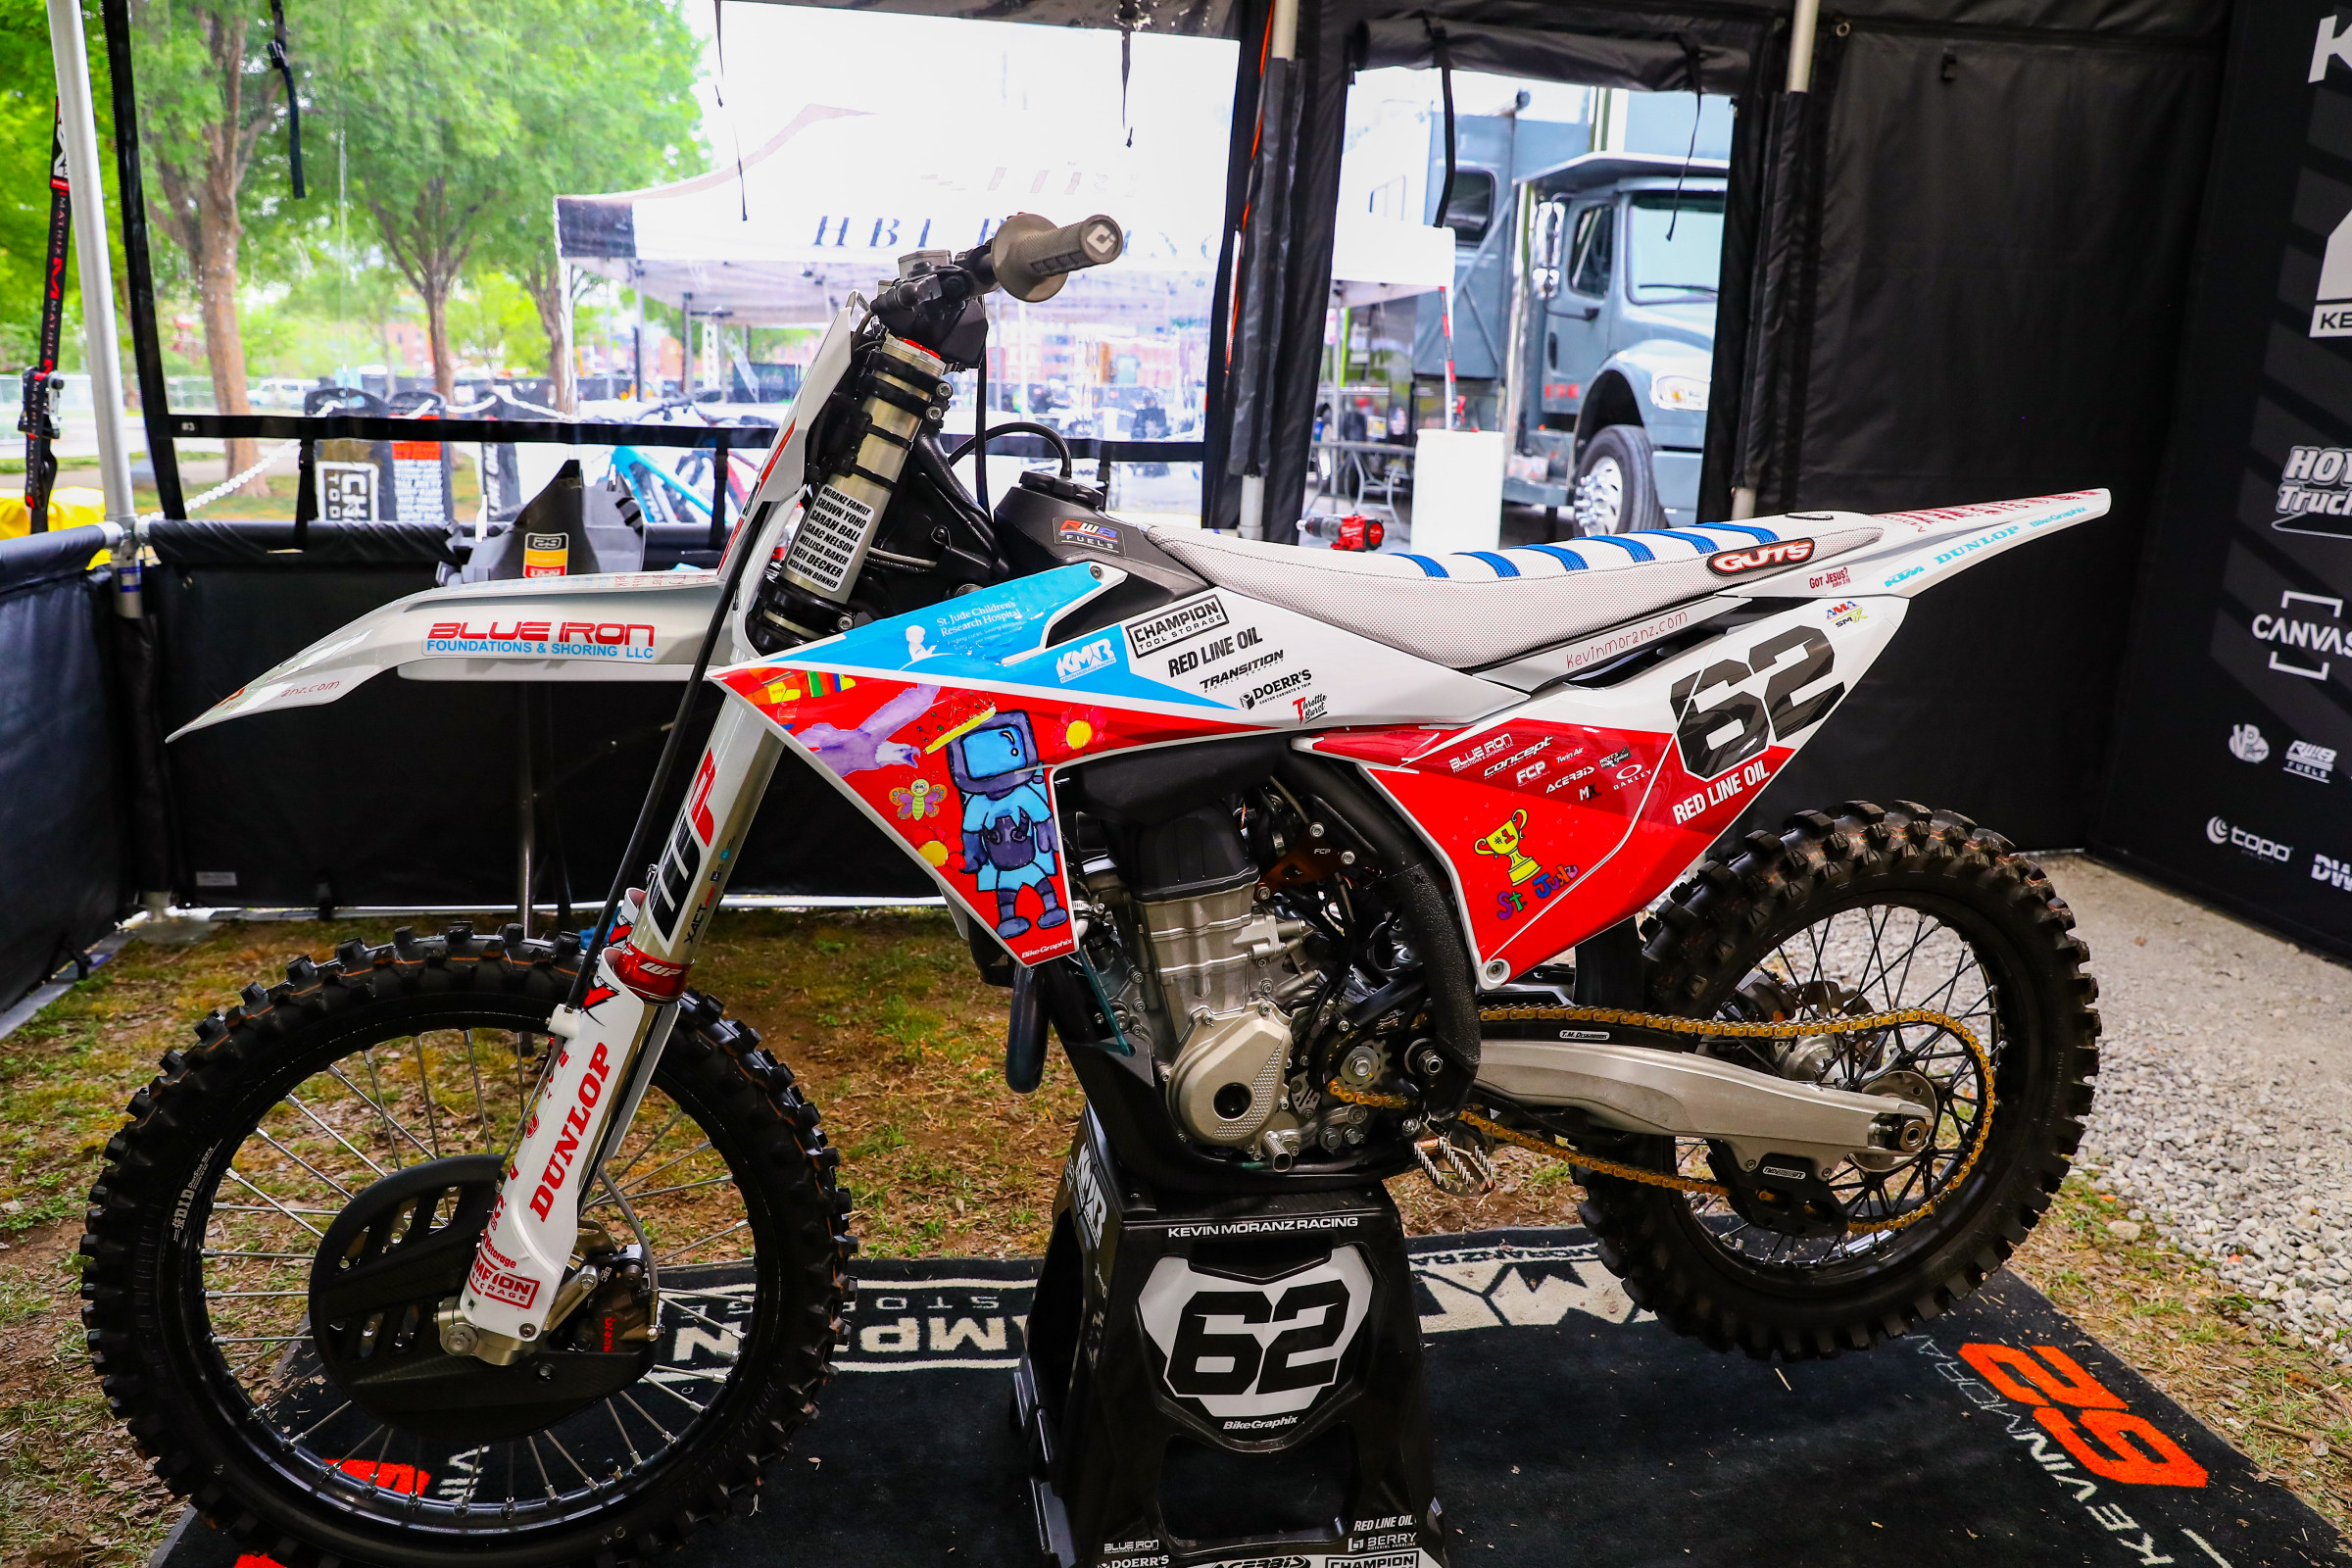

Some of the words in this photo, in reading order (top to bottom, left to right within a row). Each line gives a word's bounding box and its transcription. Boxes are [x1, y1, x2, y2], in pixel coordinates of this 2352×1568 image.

[815, 498, 845, 517] SHAWN
[843, 511, 866, 528] YOHO
[847, 499, 871, 515] FAMILY
[805, 522, 824, 539] ISAAC
[824, 534, 855, 554] NELSON
[809, 510, 838, 530] SARAH
[838, 525, 861, 542] BALL
[824, 547, 849, 565] BAKER
[1066, 535, 1113, 549] FUELS
[1712, 541, 1813, 572] GUTS
[1935, 525, 2020, 564] DUNLOP
[808, 553, 843, 577] DECKER
[812, 570, 838, 588] BONNER
[1885, 565, 1925, 588] KTM
[937, 616, 950, 627] St.
[950, 611, 971, 624] Jude
[971, 601, 1016, 617] Children's
[941, 619, 983, 636] Research
[983, 609, 1021, 626] Hospital
[1134, 601, 1219, 643] CHAMPION
[1826, 601, 1858, 619] AMA
[427, 621, 552, 641] BLUE
[559, 622, 656, 647] IRON
[1139, 635, 1167, 651] TOOL
[1172, 614, 1222, 637] STORAGE
[1566, 612, 1688, 669] kevinmoranz.com
[427, 640, 531, 654] FOUNDATIONS
[536, 643, 546, 654] &
[552, 643, 617, 657] SHORING
[626, 647, 654, 659] LLC
[1168, 651, 1199, 678] RED
[1200, 636, 1235, 663] LINE
[1236, 626, 1263, 651] OIL
[1200, 649, 1284, 690] TRANSITION
[1252, 668, 1312, 701] DOERR'S
[1670, 624, 1845, 779] 62
[1448, 746, 1485, 770] BLUE
[1484, 733, 1513, 754] IRON
[1484, 736, 1553, 777] concept
[1556, 752, 1573, 764] Twin
[1573, 746, 1584, 758] Air
[1516, 760, 1546, 784] FCP
[1545, 765, 1594, 794] ACERBIS
[1613, 768, 1651, 791] OAKLEY
[2287, 761, 2328, 779] FUELS
[1672, 792, 1707, 825] RED
[1706, 773, 1743, 807] LINE
[1743, 760, 1771, 787] OIL
[2231, 825, 2291, 862] topo
[1496, 890, 1528, 921] St.
[684, 904, 707, 945] XACT
[529, 1042, 610, 1223] DUNLOP
[1168, 1225, 1219, 1238] KEVIN
[1221, 1220, 1296, 1235] MORANZ
[1297, 1217, 1358, 1230] RACING
[1166, 1279, 1350, 1395] 62
[1223, 1415, 1298, 1430] BikeGraphix
[2012, 1432, 2175, 1566] KEVIN
[1354, 1520, 1374, 1532] RED
[1375, 1518, 1396, 1529] LINE
[1398, 1515, 1413, 1526] OIL
[1103, 1542, 1135, 1552] BLUE
[1367, 1533, 1417, 1547] BERRY
[1111, 1555, 1170, 1568] DOERR'S
